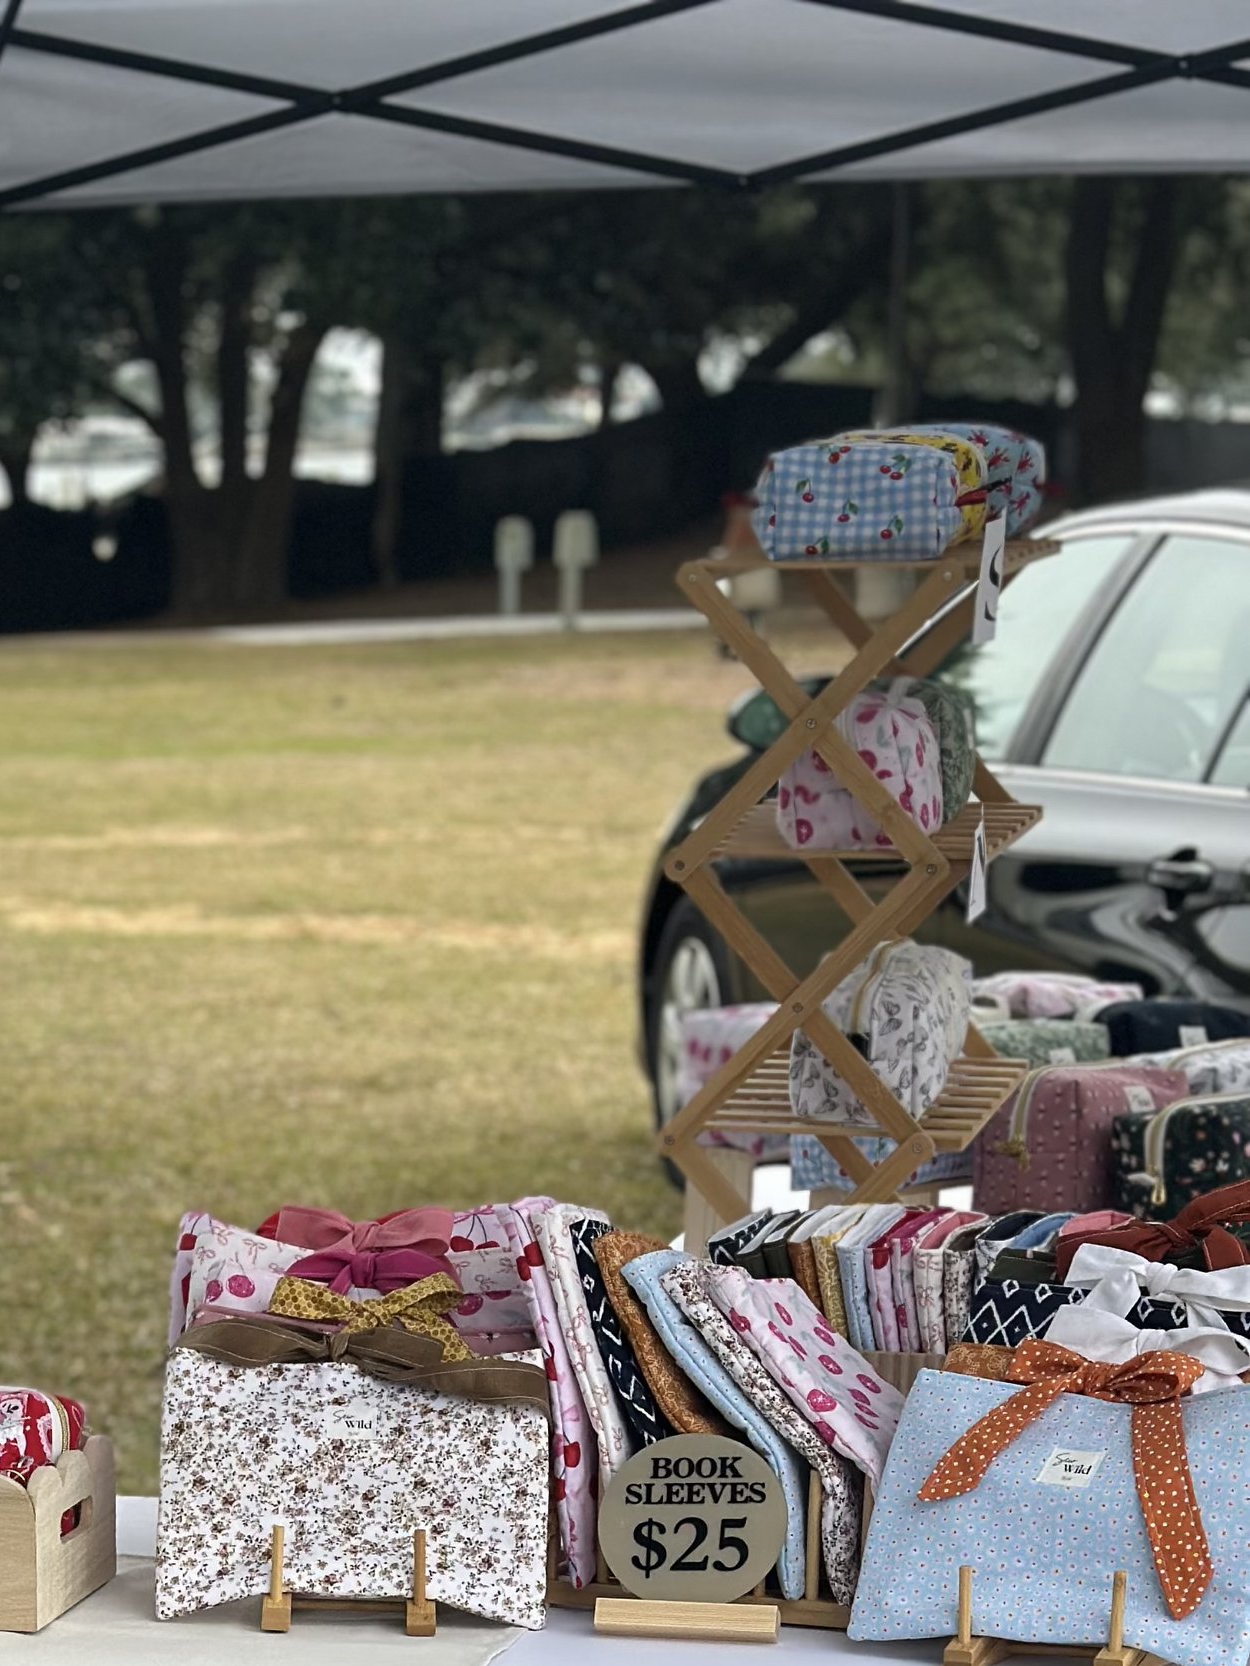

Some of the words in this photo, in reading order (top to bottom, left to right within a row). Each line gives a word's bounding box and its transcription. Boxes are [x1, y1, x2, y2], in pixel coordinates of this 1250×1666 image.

[650, 1456, 743, 1479] BOOK
[625, 1482, 767, 1505] SLEEVES
[631, 1517, 749, 1579] $25
